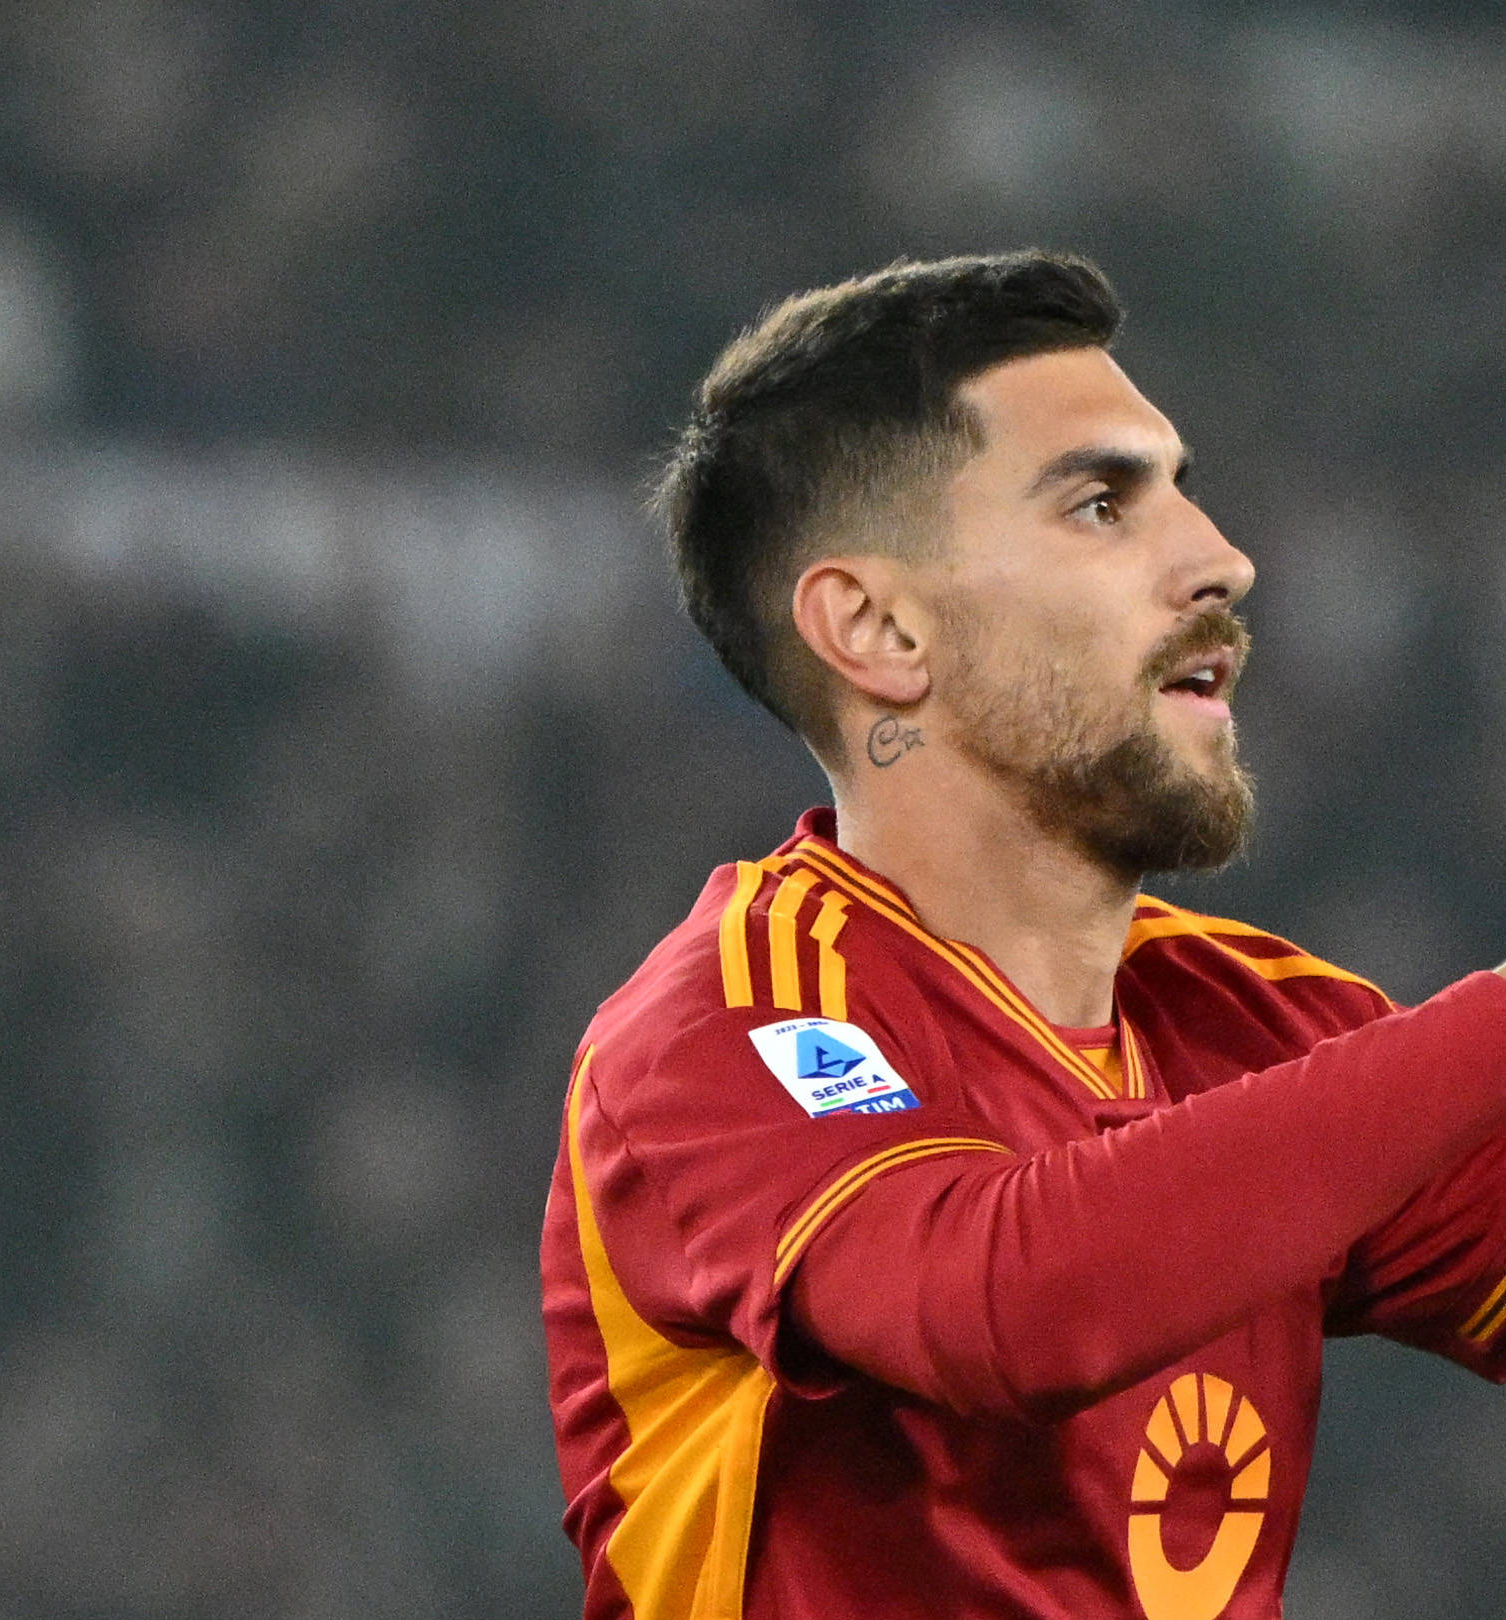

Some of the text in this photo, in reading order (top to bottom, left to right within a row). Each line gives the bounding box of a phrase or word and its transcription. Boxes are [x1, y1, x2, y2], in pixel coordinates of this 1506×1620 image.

[812, 1074, 886, 1100] SERIE A
[855, 1097, 906, 1114] TIM
